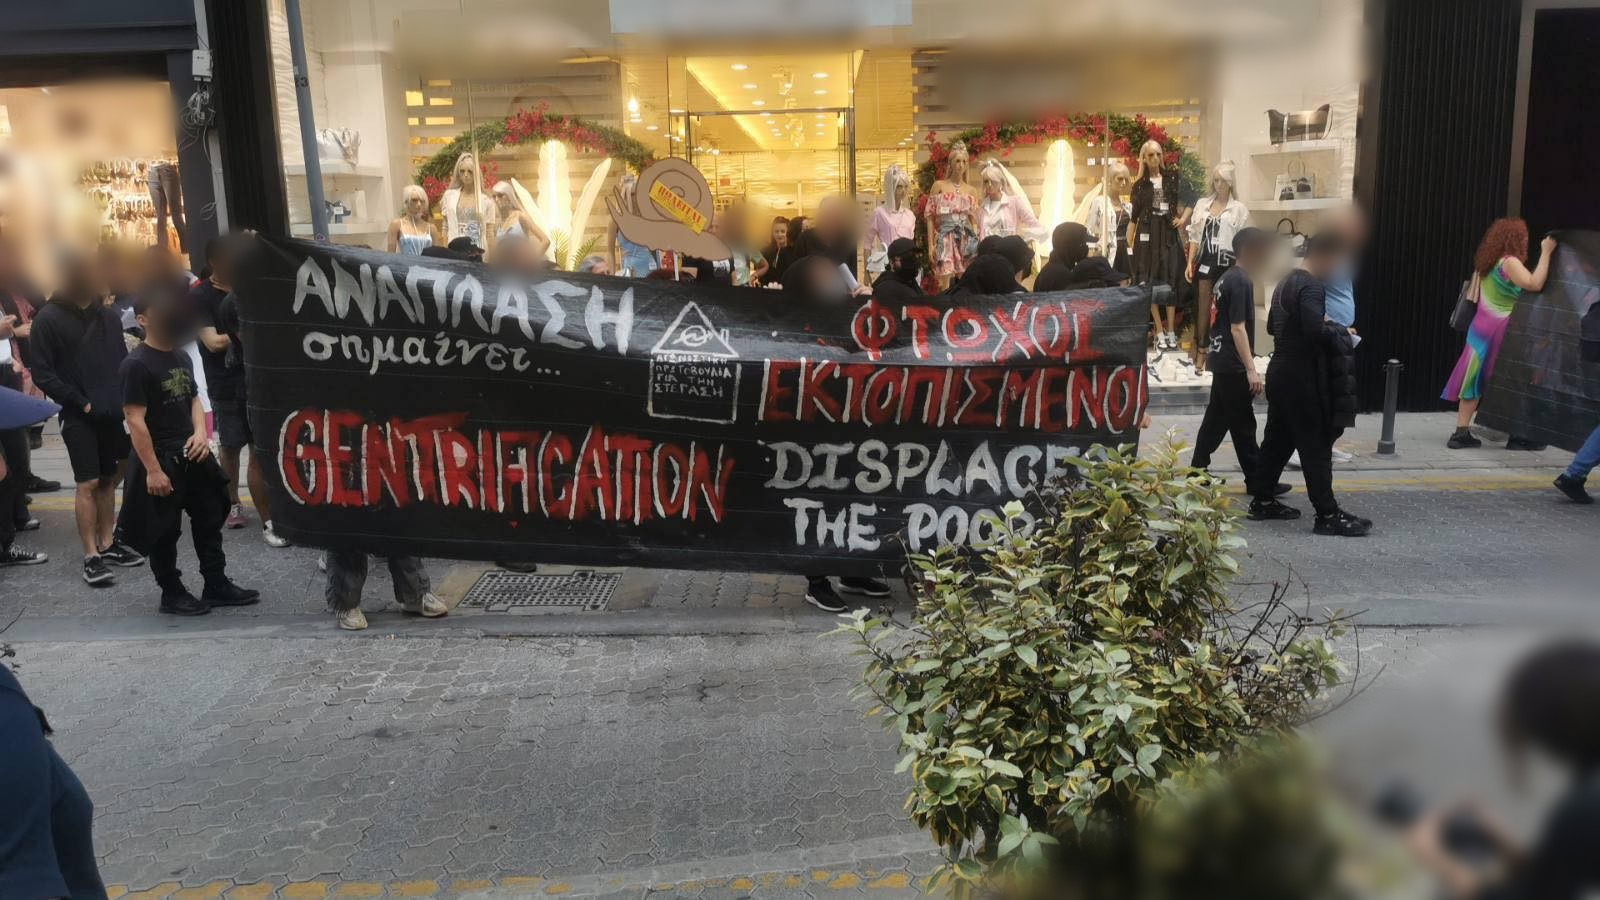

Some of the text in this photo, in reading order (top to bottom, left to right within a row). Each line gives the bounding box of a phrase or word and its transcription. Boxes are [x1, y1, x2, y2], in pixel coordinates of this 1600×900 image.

[293, 255, 635, 356] ΑΝΑΠΛΑΣΗ
[850, 299, 1105, 365] ΦΤΩΧΟΙ
[654, 383, 723, 397] ΣΤΕΓΑΣΗ
[656, 365, 732, 378] ΠΡΩΤΟΒΟΥΛΙΑ
[657, 373, 715, 387] ΓΙΑ ΤΗΝ
[757, 357, 1150, 434] ΕΚΤΟΠΙΣΜΕΝΟΙ
[278, 408, 735, 525] GENTRIFICATION
[784, 497, 882, 553] THE
